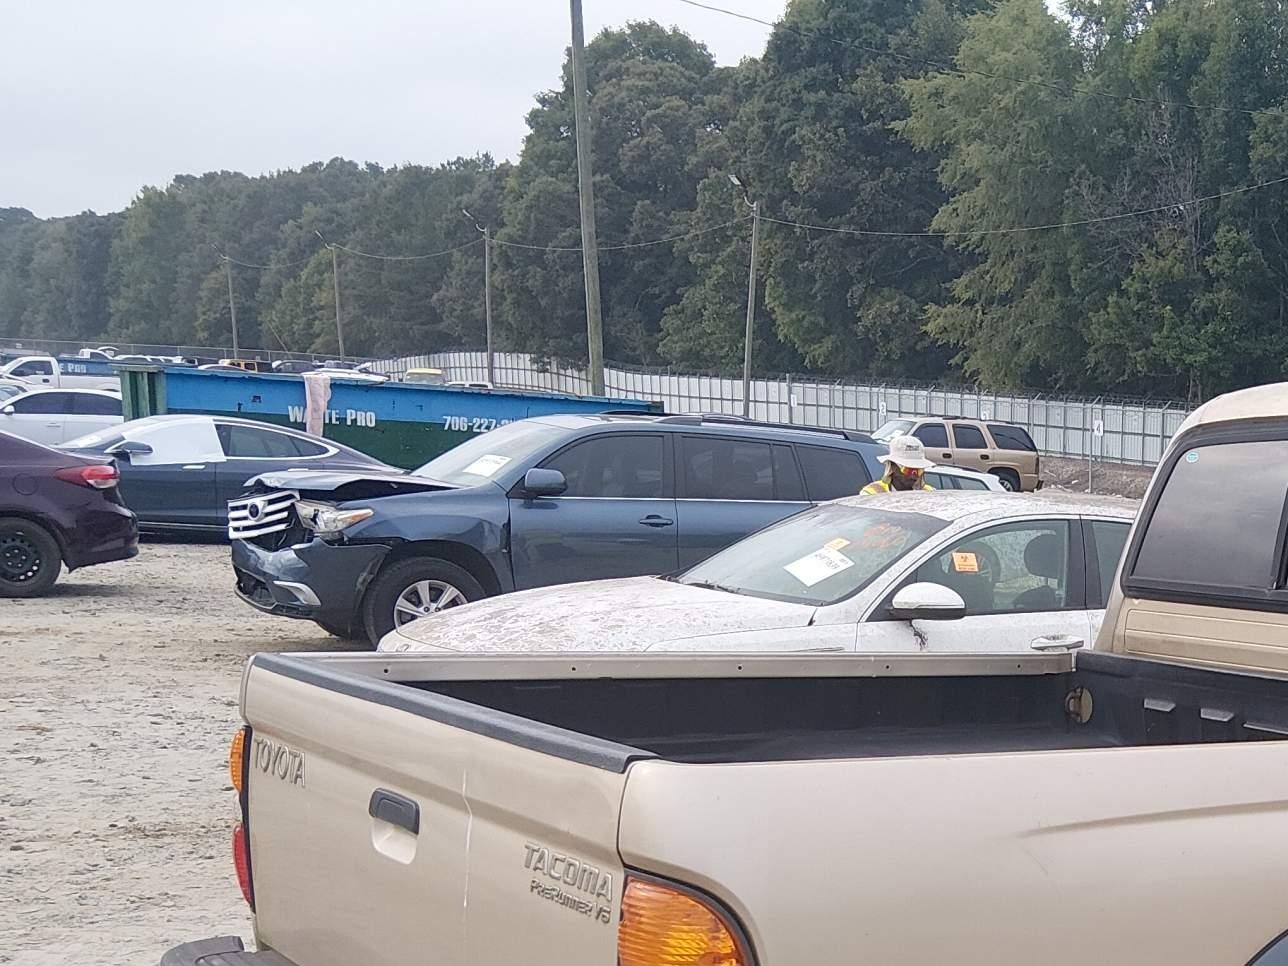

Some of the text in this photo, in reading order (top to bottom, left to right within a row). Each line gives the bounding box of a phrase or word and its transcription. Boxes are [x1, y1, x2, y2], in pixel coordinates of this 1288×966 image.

[288, 405, 376, 428] WTE PRO
[254, 738, 306, 788] TOYOTA
[524, 841, 613, 903] TACOMA
[593, 901, 611, 924] V6
